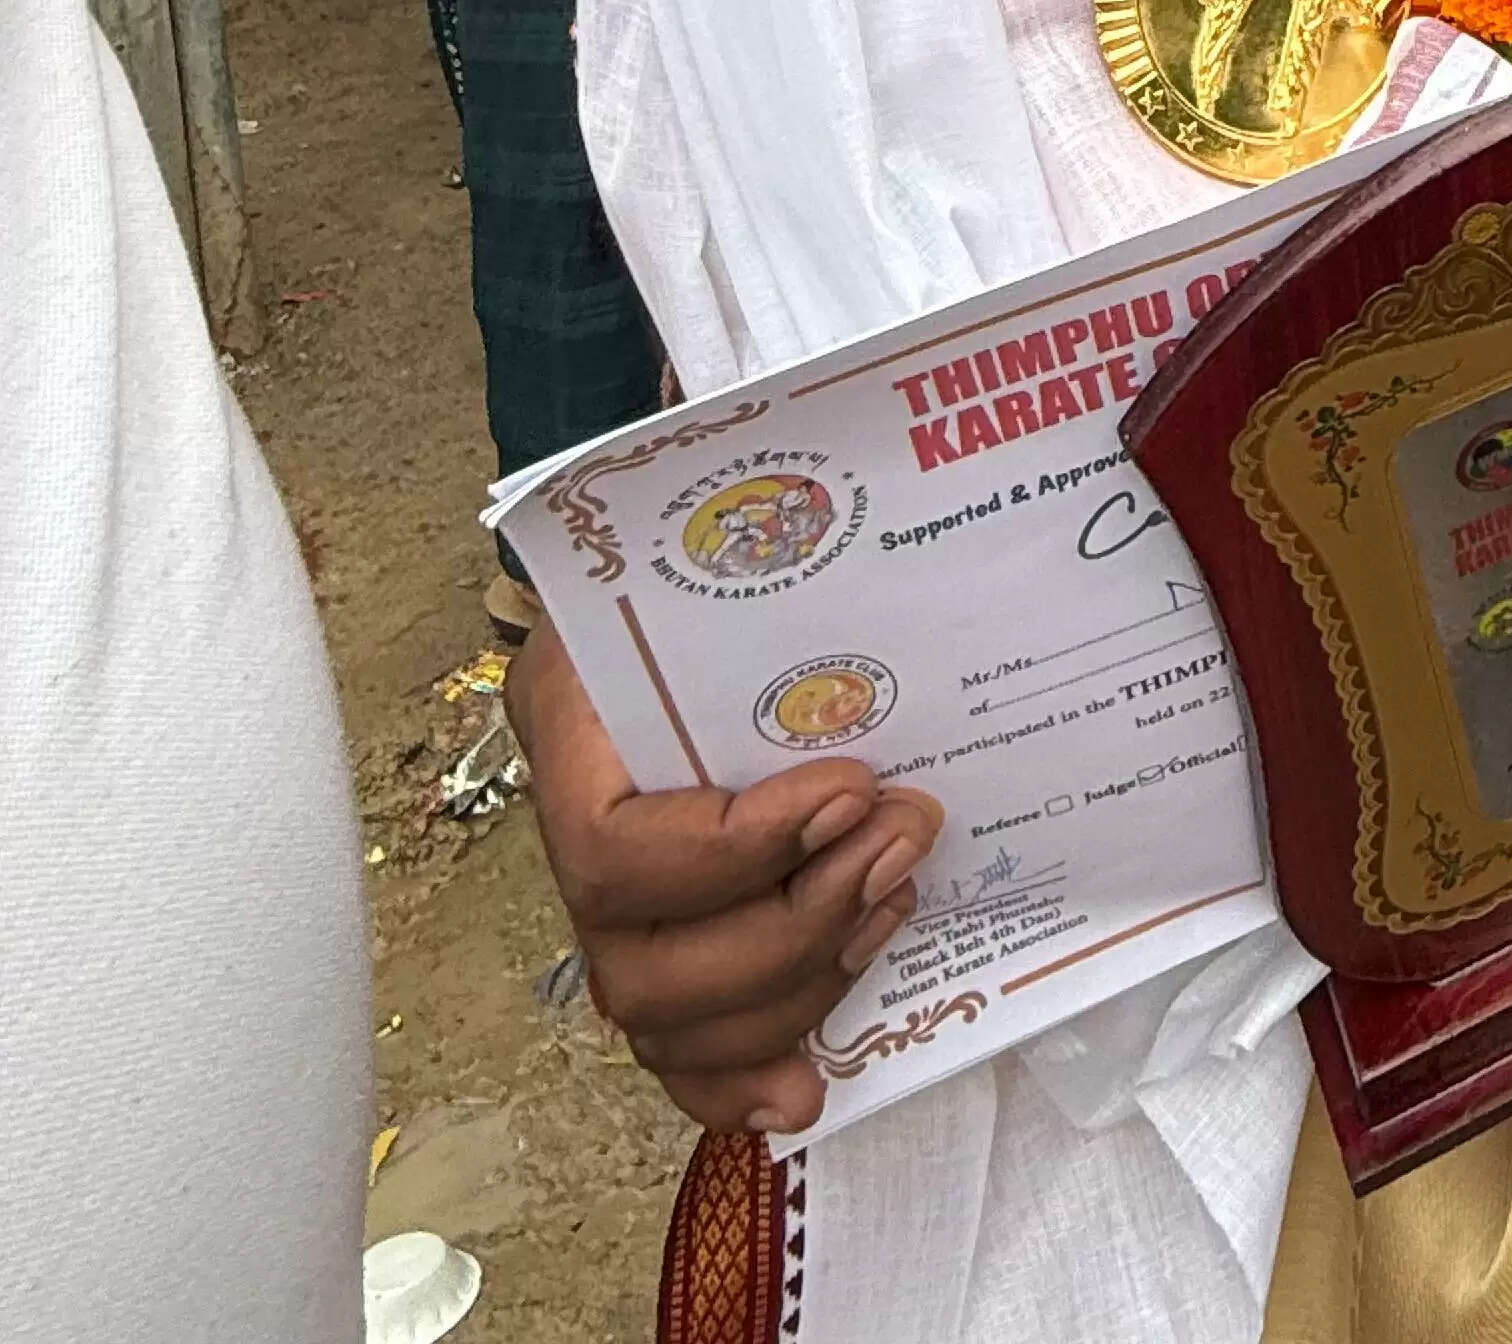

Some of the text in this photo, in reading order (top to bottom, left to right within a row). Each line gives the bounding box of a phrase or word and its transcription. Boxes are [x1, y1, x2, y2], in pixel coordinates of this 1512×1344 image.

[892, 289, 1174, 418] THIMPHU
[908, 352, 1144, 474] KARATE
[650, 555, 712, 597] BHUTAN
[713, 575, 798, 599] KARATE
[801, 485, 870, 582] ASSOCIATION
[880, 493, 1002, 551] Supported
[1010, 483, 1031, 505] &
[943, 714, 1056, 764] participated
[1061, 709, 1081, 726] in
[1084, 694, 1116, 716] the
[1136, 705, 1175, 730] held
[1180, 698, 1205, 714] on
[970, 740, 1238, 839] Referee Judge Official
[880, 914, 1089, 1010] Bhutan Karate Association
[899, 950, 951, 981] (Black
